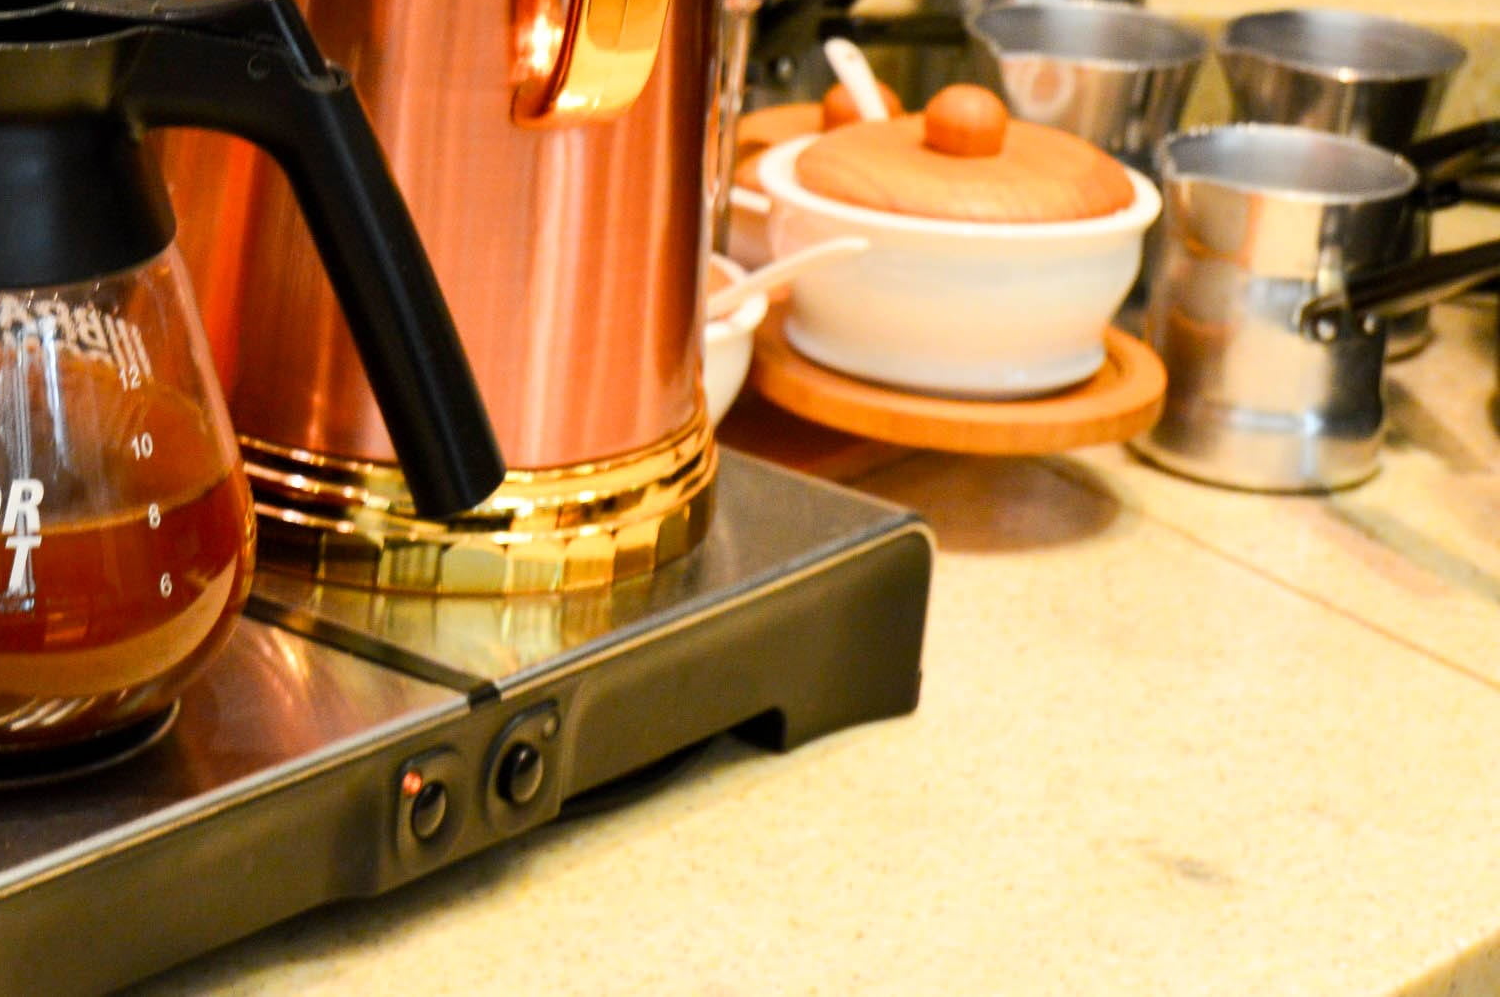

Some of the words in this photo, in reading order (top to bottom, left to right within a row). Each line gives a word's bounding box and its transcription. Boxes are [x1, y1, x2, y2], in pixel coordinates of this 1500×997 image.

[119, 367, 143, 392] 12
[130, 433, 154, 462] 10
[148, 503, 162, 531] 8
[159, 573, 174, 599] 6
